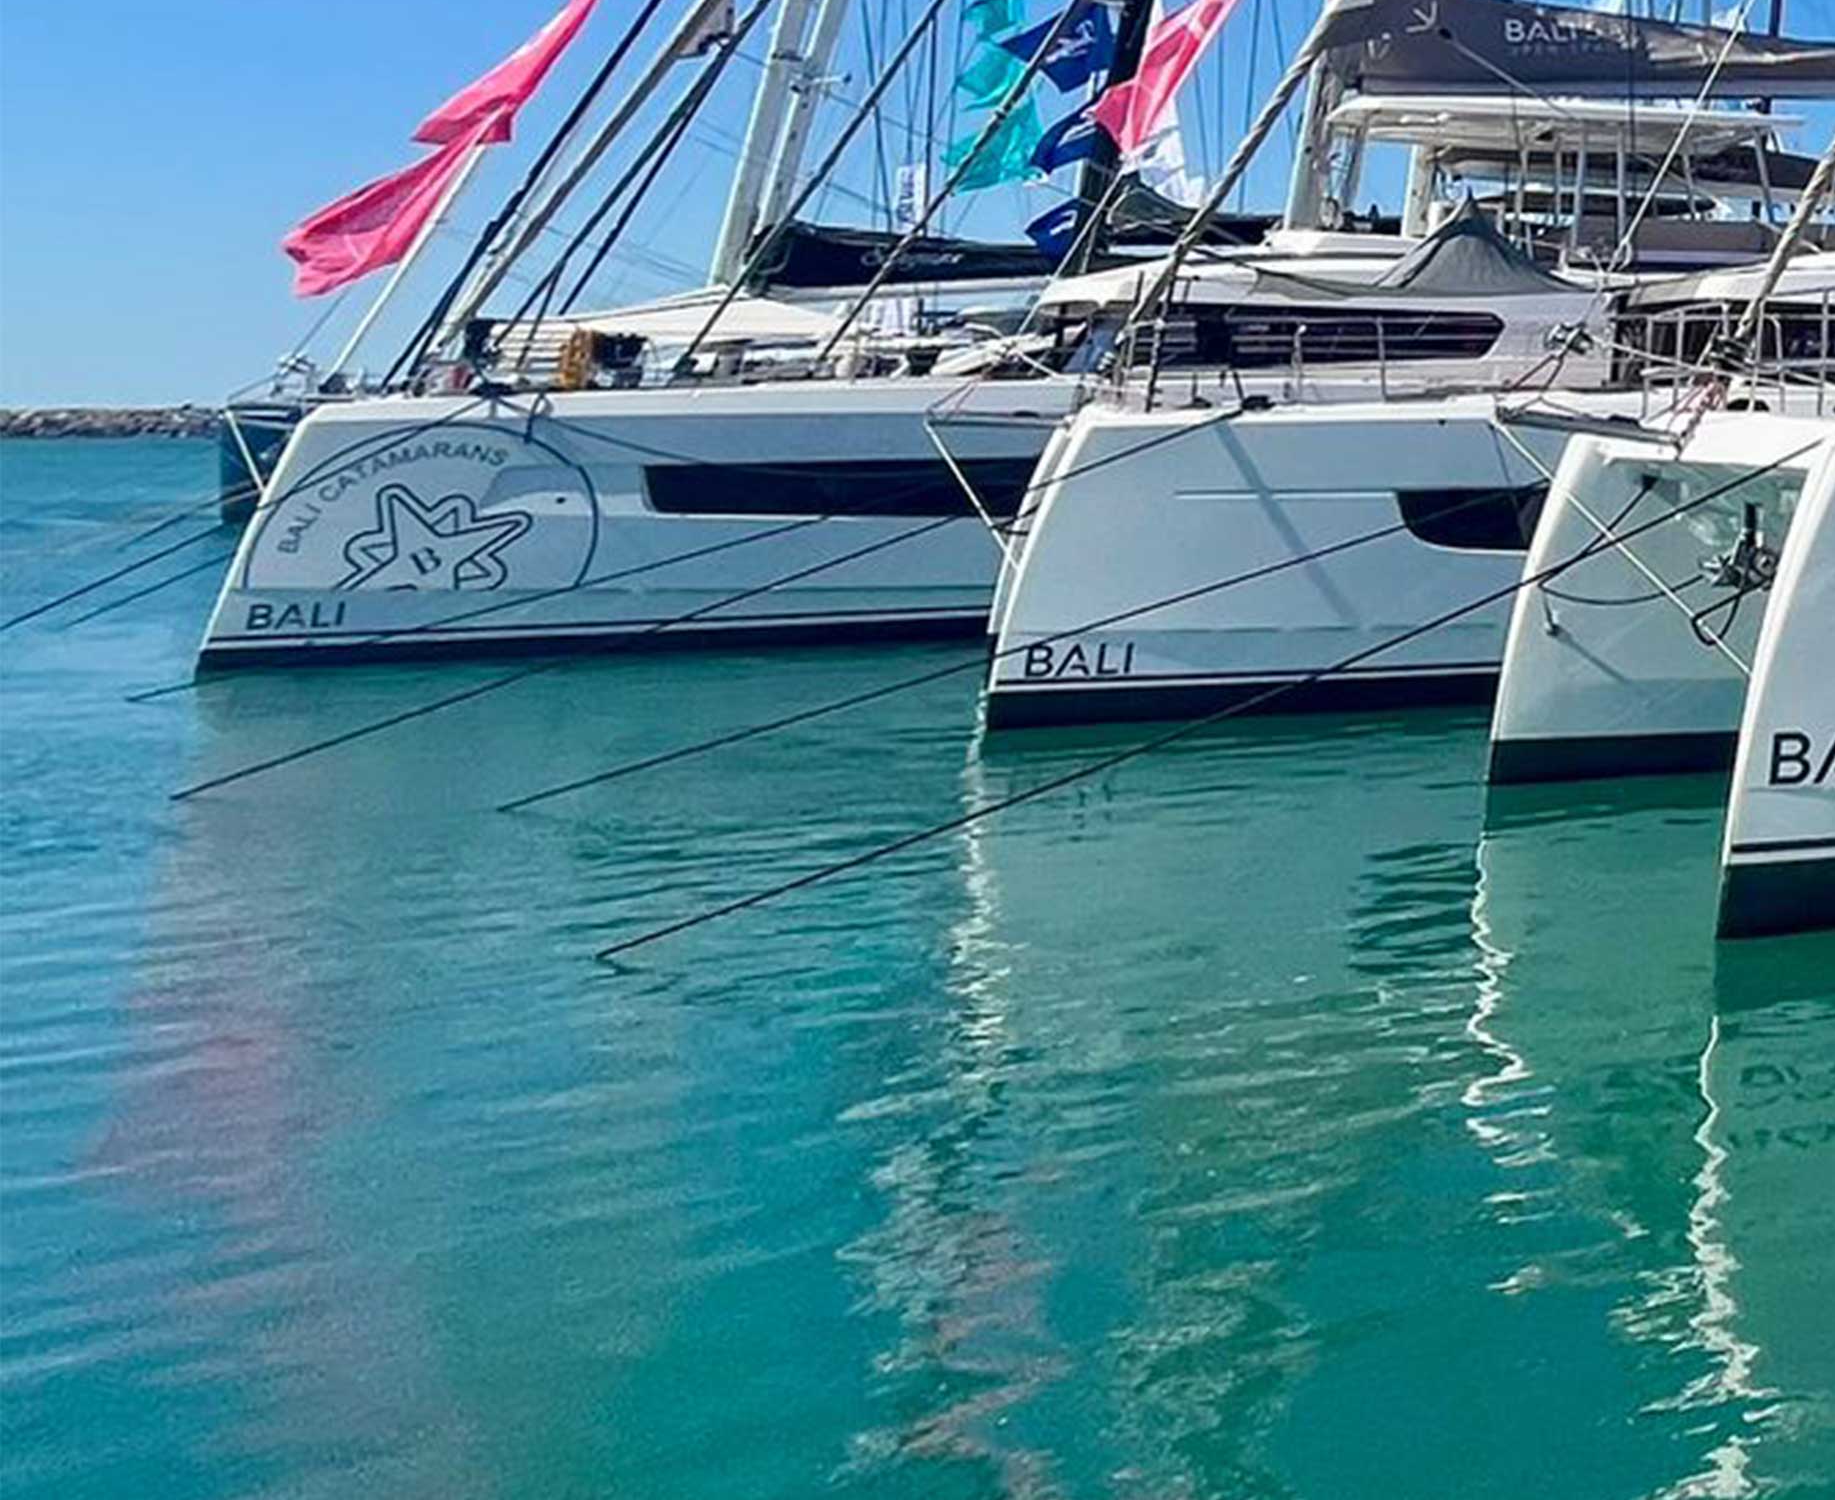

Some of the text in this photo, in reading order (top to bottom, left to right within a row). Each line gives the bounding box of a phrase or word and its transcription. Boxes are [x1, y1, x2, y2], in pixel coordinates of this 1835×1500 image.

[277, 440, 511, 555] BALI CATAMARANS
[245, 601, 346, 631] BALI
[1023, 641, 1136, 678] BALI
